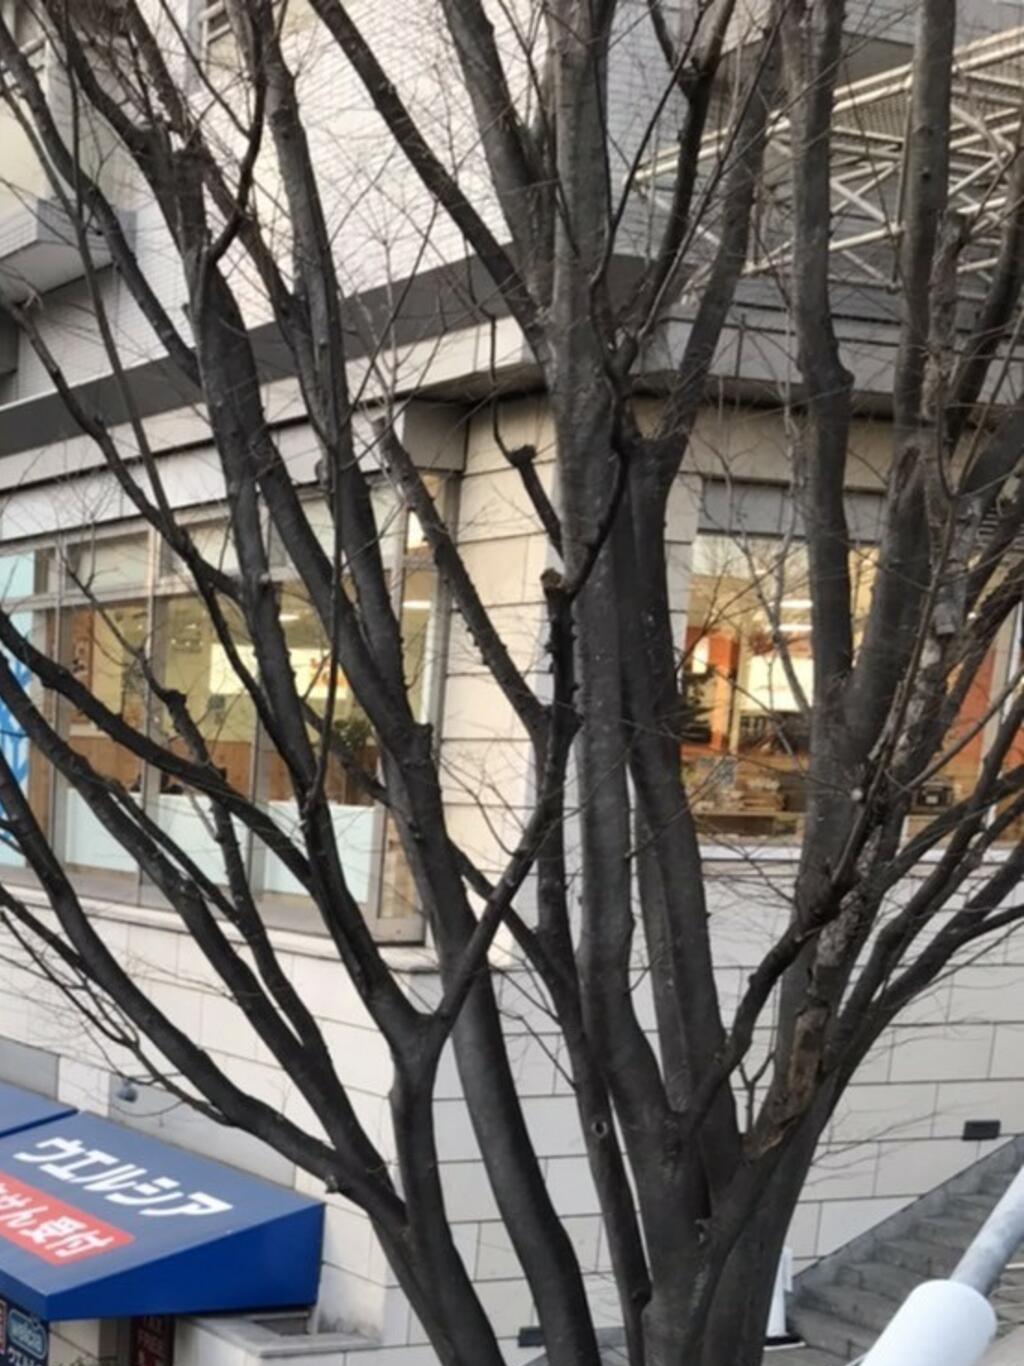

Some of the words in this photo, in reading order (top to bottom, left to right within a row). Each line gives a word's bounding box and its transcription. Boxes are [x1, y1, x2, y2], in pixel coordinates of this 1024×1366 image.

[13, 1136, 234, 1216] ウエルシア
